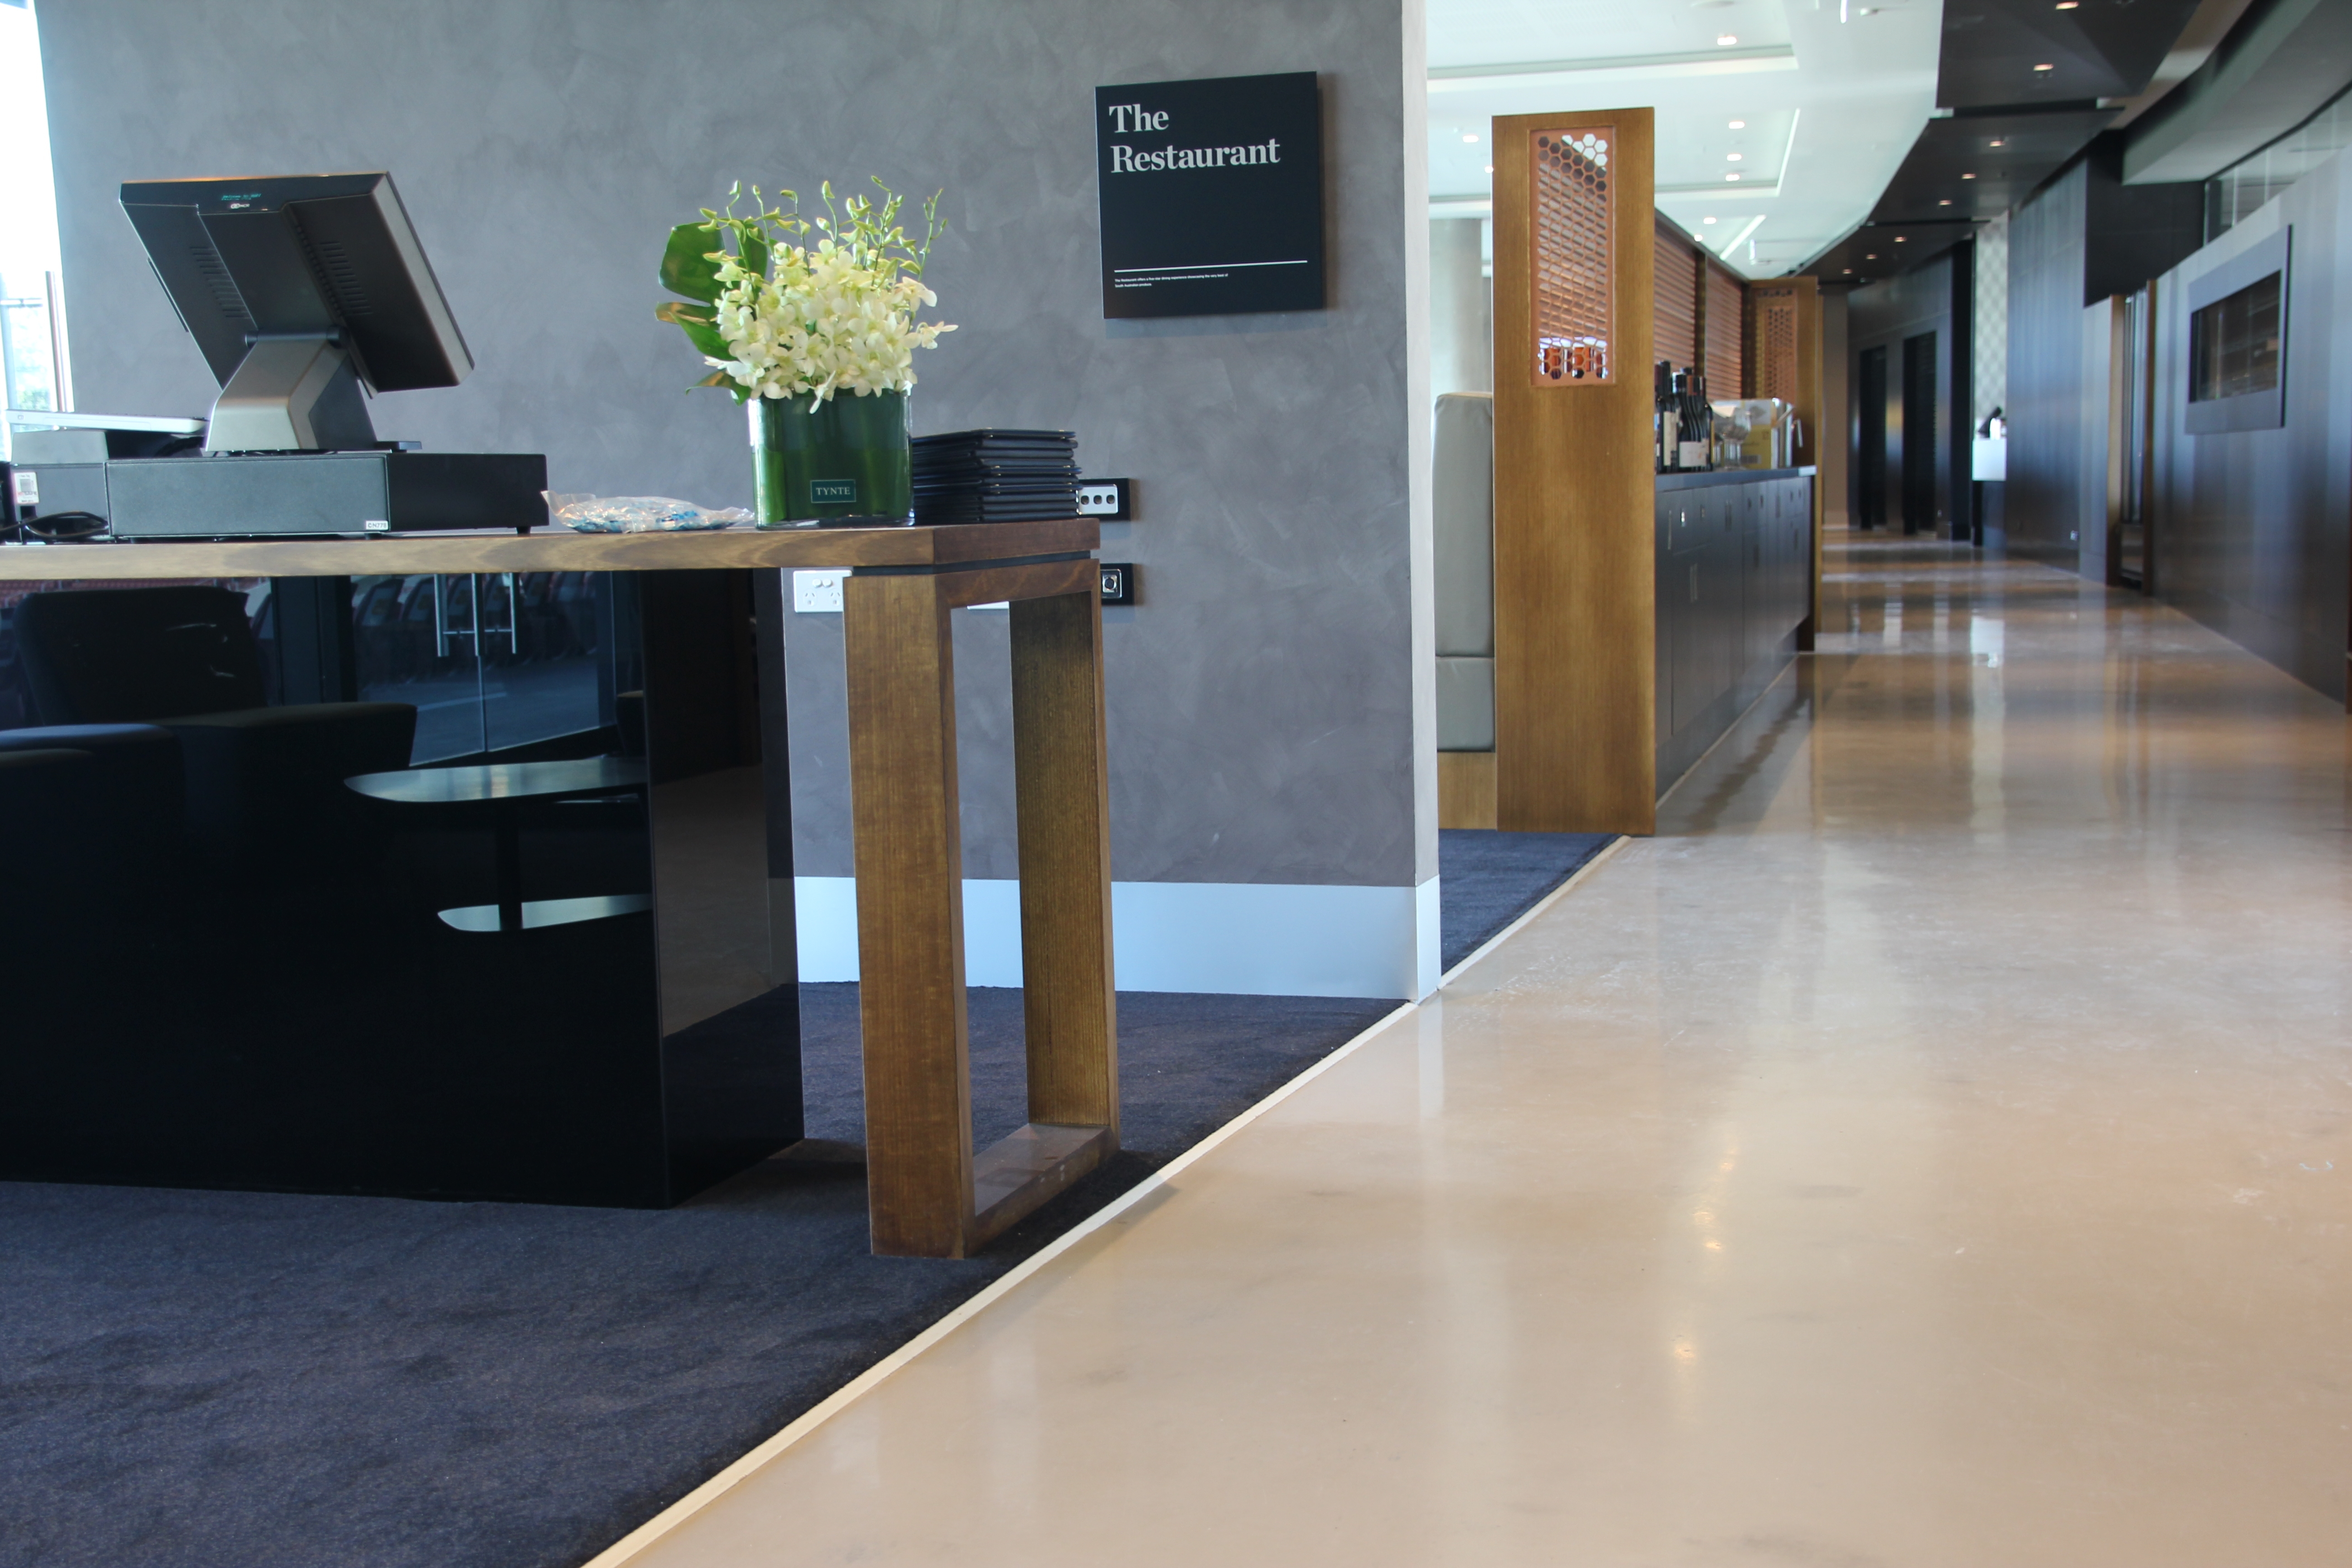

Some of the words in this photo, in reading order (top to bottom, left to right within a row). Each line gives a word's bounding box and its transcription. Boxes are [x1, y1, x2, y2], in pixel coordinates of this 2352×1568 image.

[1109, 103, 1169, 133] The
[1110, 138, 1281, 173] Restaurant
[816, 487, 851, 495] TYNTE
